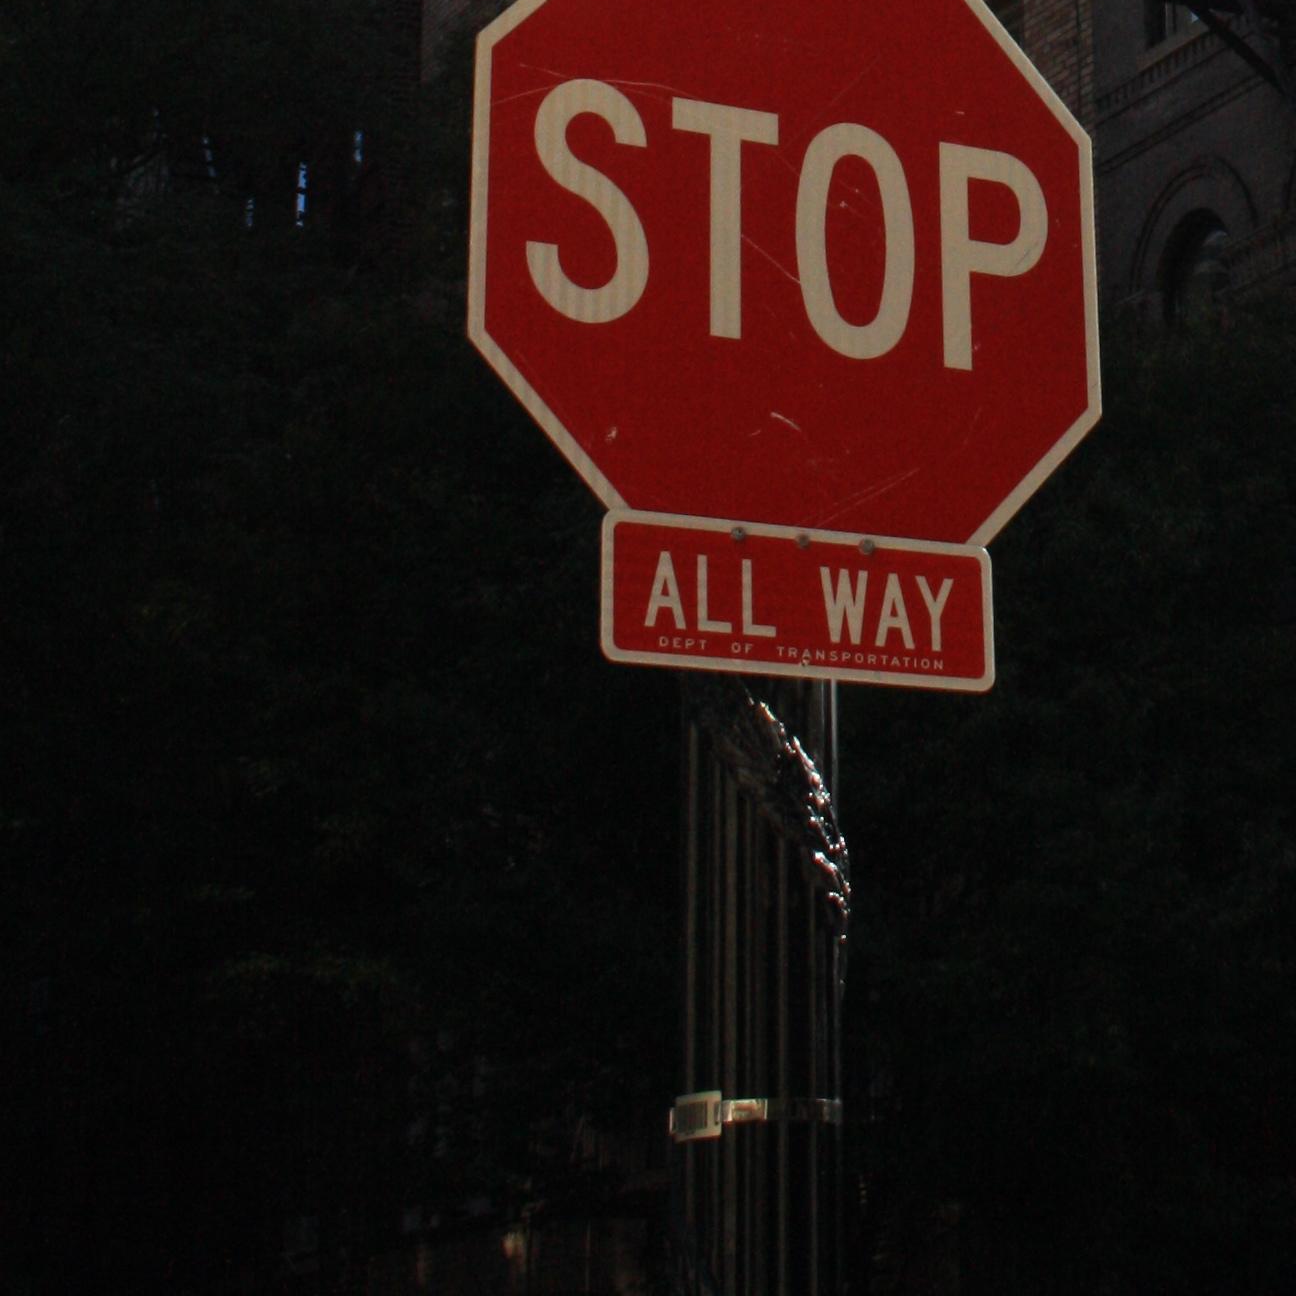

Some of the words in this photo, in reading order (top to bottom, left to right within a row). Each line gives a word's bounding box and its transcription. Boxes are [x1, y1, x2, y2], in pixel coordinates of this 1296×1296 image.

[525, 78, 1051, 371] STOP
[644, 550, 777, 638] ALL
[820, 566, 954, 653] WAY
[657, 634, 709, 653] DEPT
[731, 641, 754, 655] OF
[777, 645, 946, 672] TRANSPORTATION
